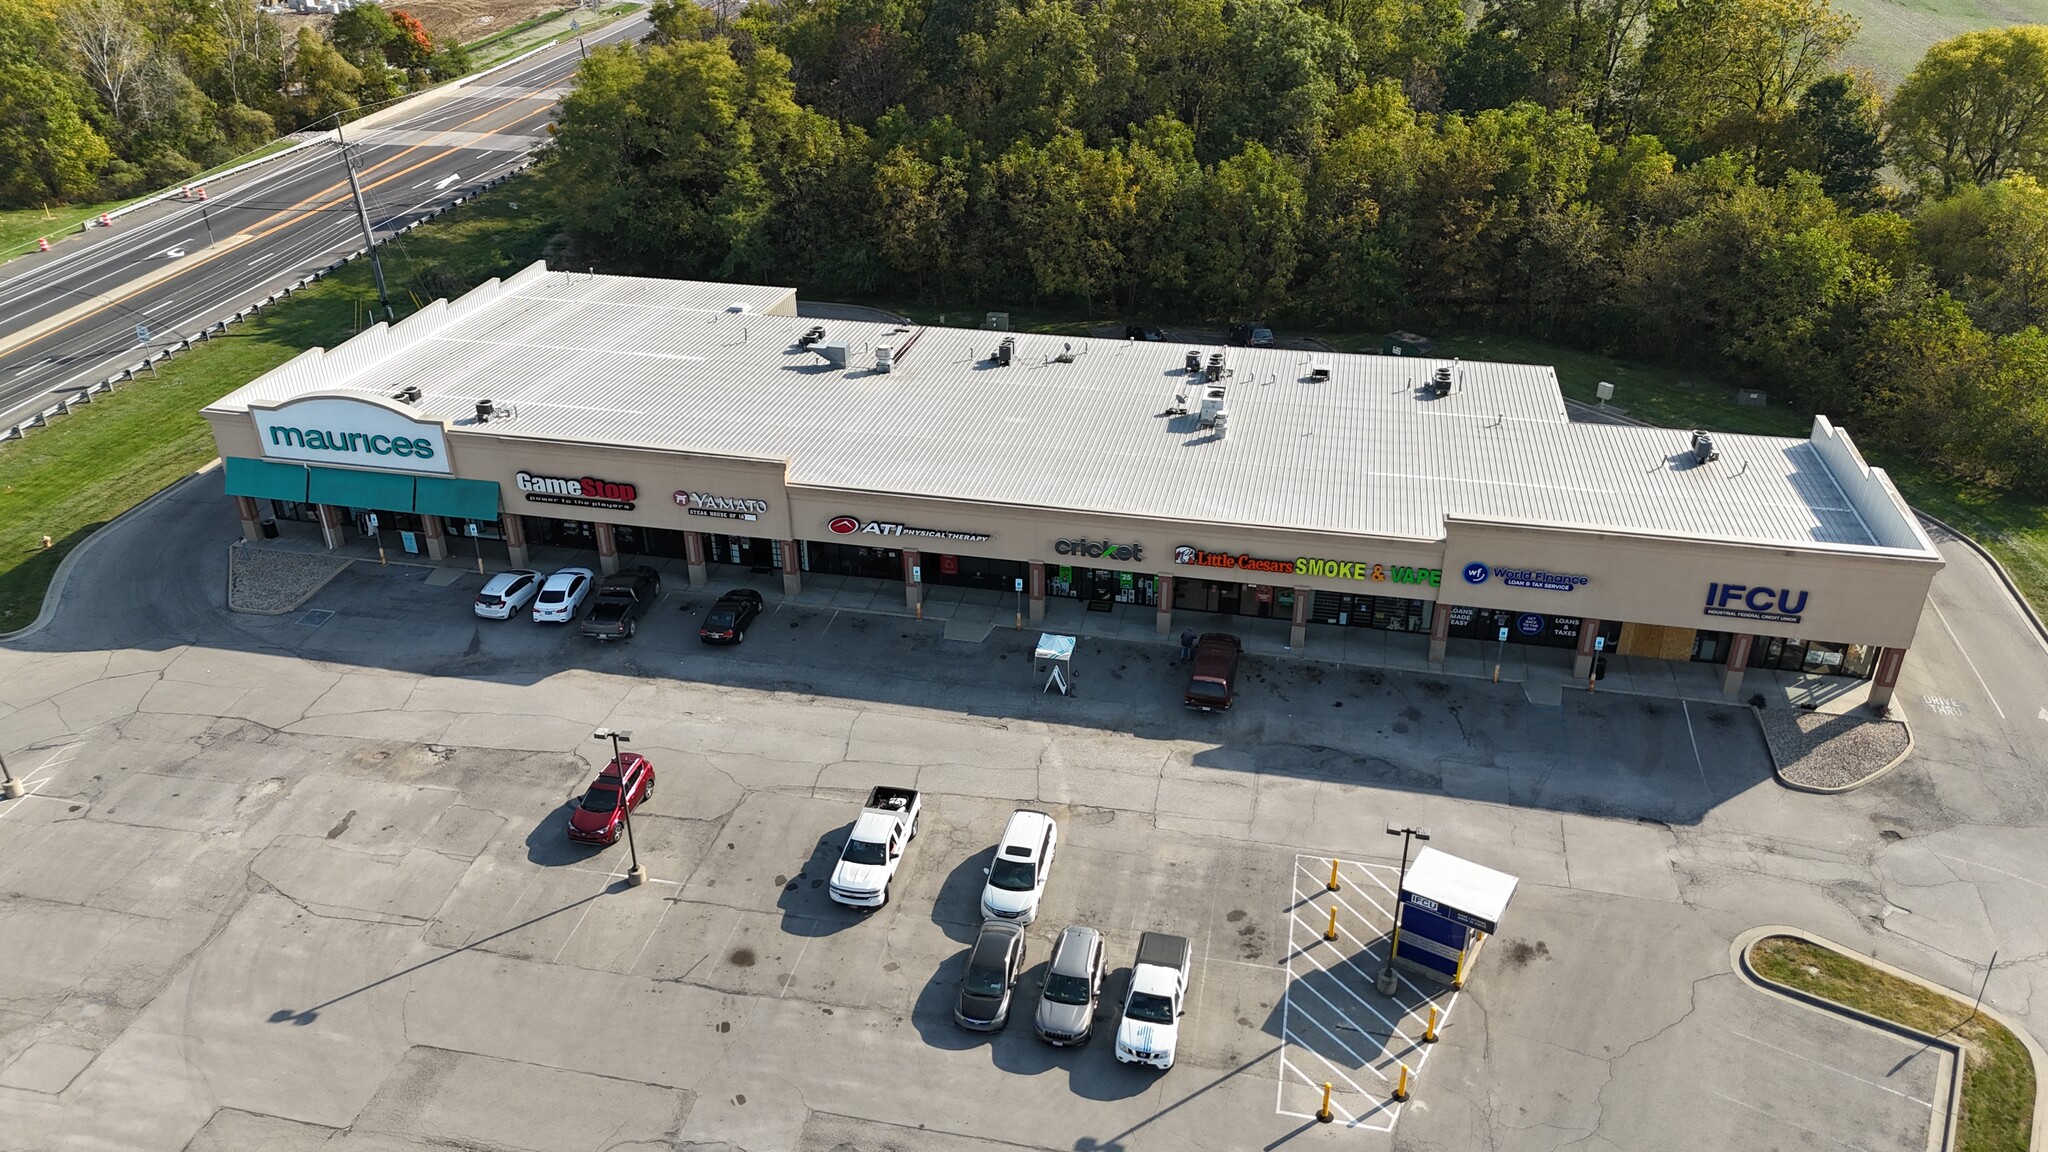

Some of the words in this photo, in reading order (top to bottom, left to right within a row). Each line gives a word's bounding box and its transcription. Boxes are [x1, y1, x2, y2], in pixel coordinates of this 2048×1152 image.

[269, 426, 434, 459] maurices
[516, 471, 637, 501] GameStop
[529, 495, 558, 503] power
[592, 500, 630, 510] players
[691, 492, 767, 514] YAMATO
[862, 522, 903, 537] ATI
[903, 528, 945, 539] PHYSICAL
[948, 532, 989, 542] THERAPY
[1055, 536, 1143, 562] cricket
[1197, 550, 1235, 568] Little
[1238, 554, 1294, 574] Caesars
[1295, 557, 1367, 581] SMOKE
[1371, 564, 1385, 582] &
[1391, 565, 1442, 588] VAPE
[1493, 567, 1531, 580] World
[1535, 570, 1588, 586] Finance
[1544, 583, 1569, 591] SERVICE
[1705, 582, 1809, 613] IFCU
[1707, 609, 1736, 617] INDUSTRIAL
[1554, 629, 1577, 637] TAXES
[1922, 695, 1960, 707] DRIVE
[1928, 704, 1963, 716] THRU
[1412, 895, 1437, 909] IFCU
